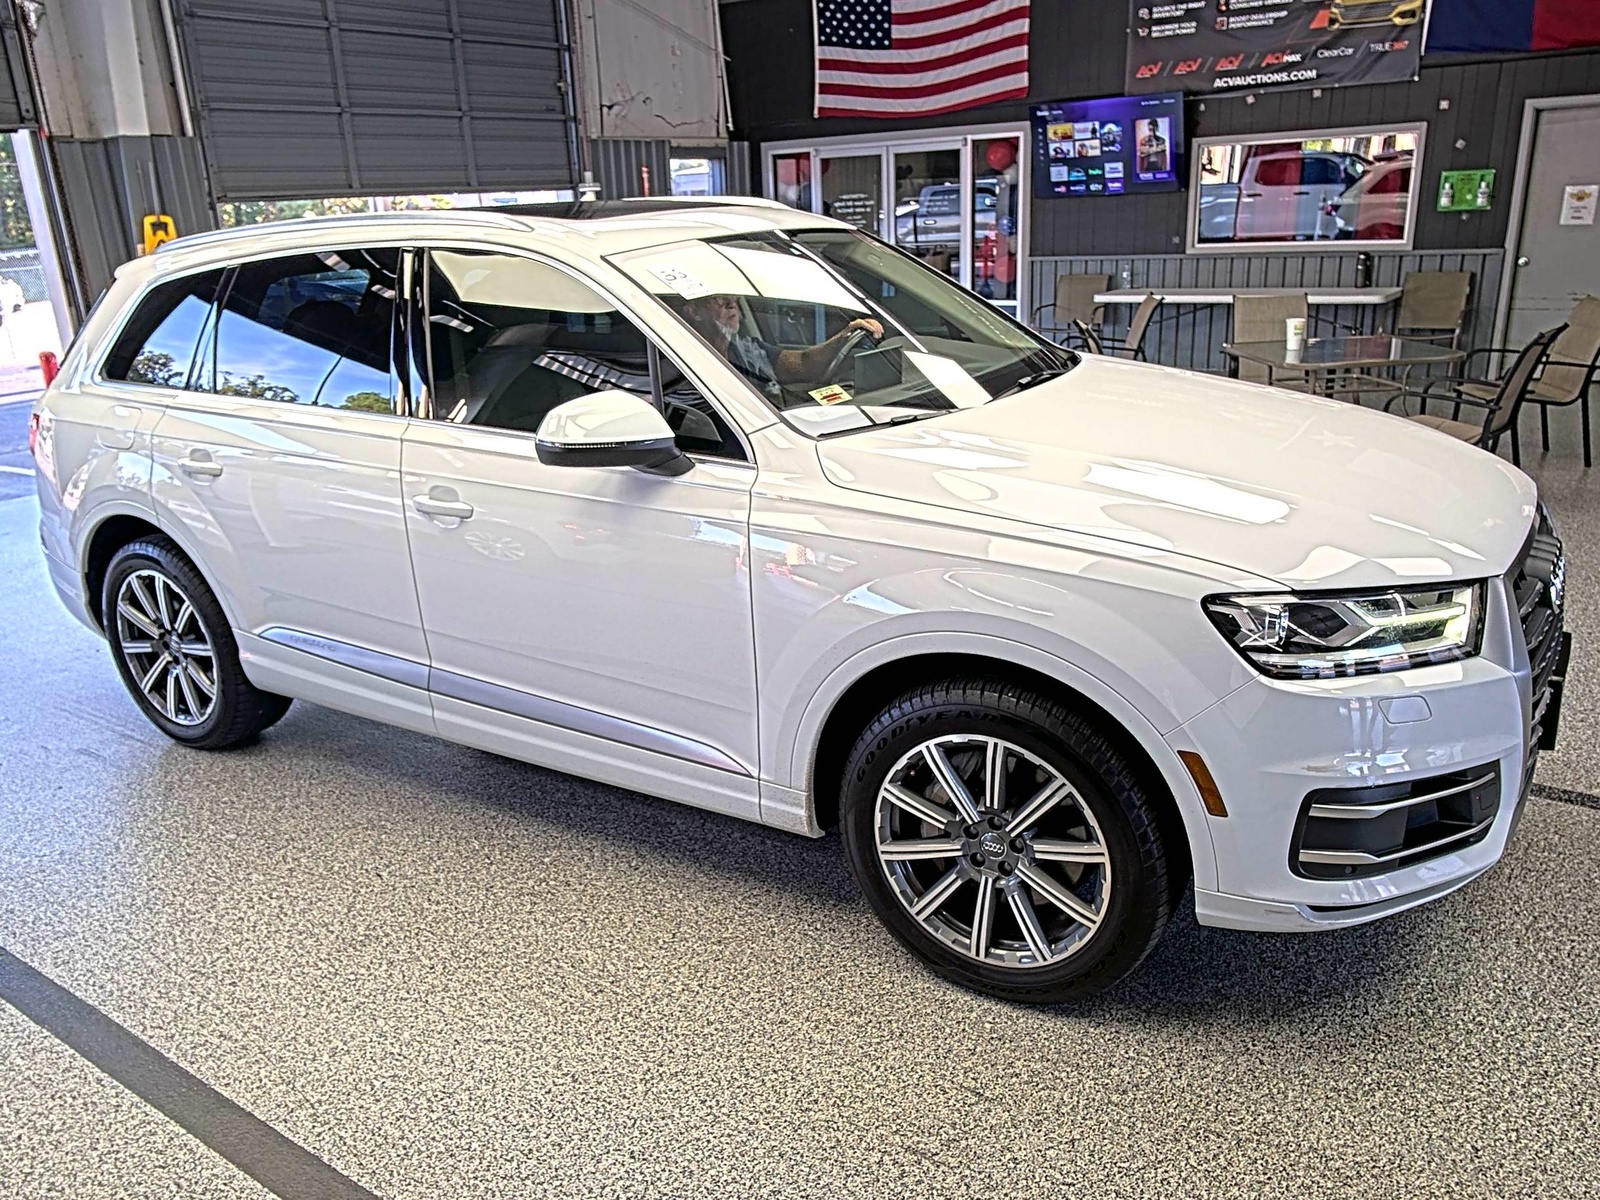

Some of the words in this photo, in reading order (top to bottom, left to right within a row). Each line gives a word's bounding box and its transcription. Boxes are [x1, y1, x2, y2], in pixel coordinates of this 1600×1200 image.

[1215, 53, 1244, 70] ACV
[1316, 46, 1355, 58] ClearCar
[1213, 70, 1317, 88] ACVAUCTIONS.COM
[856, 710, 1002, 783] GOODYEAR
